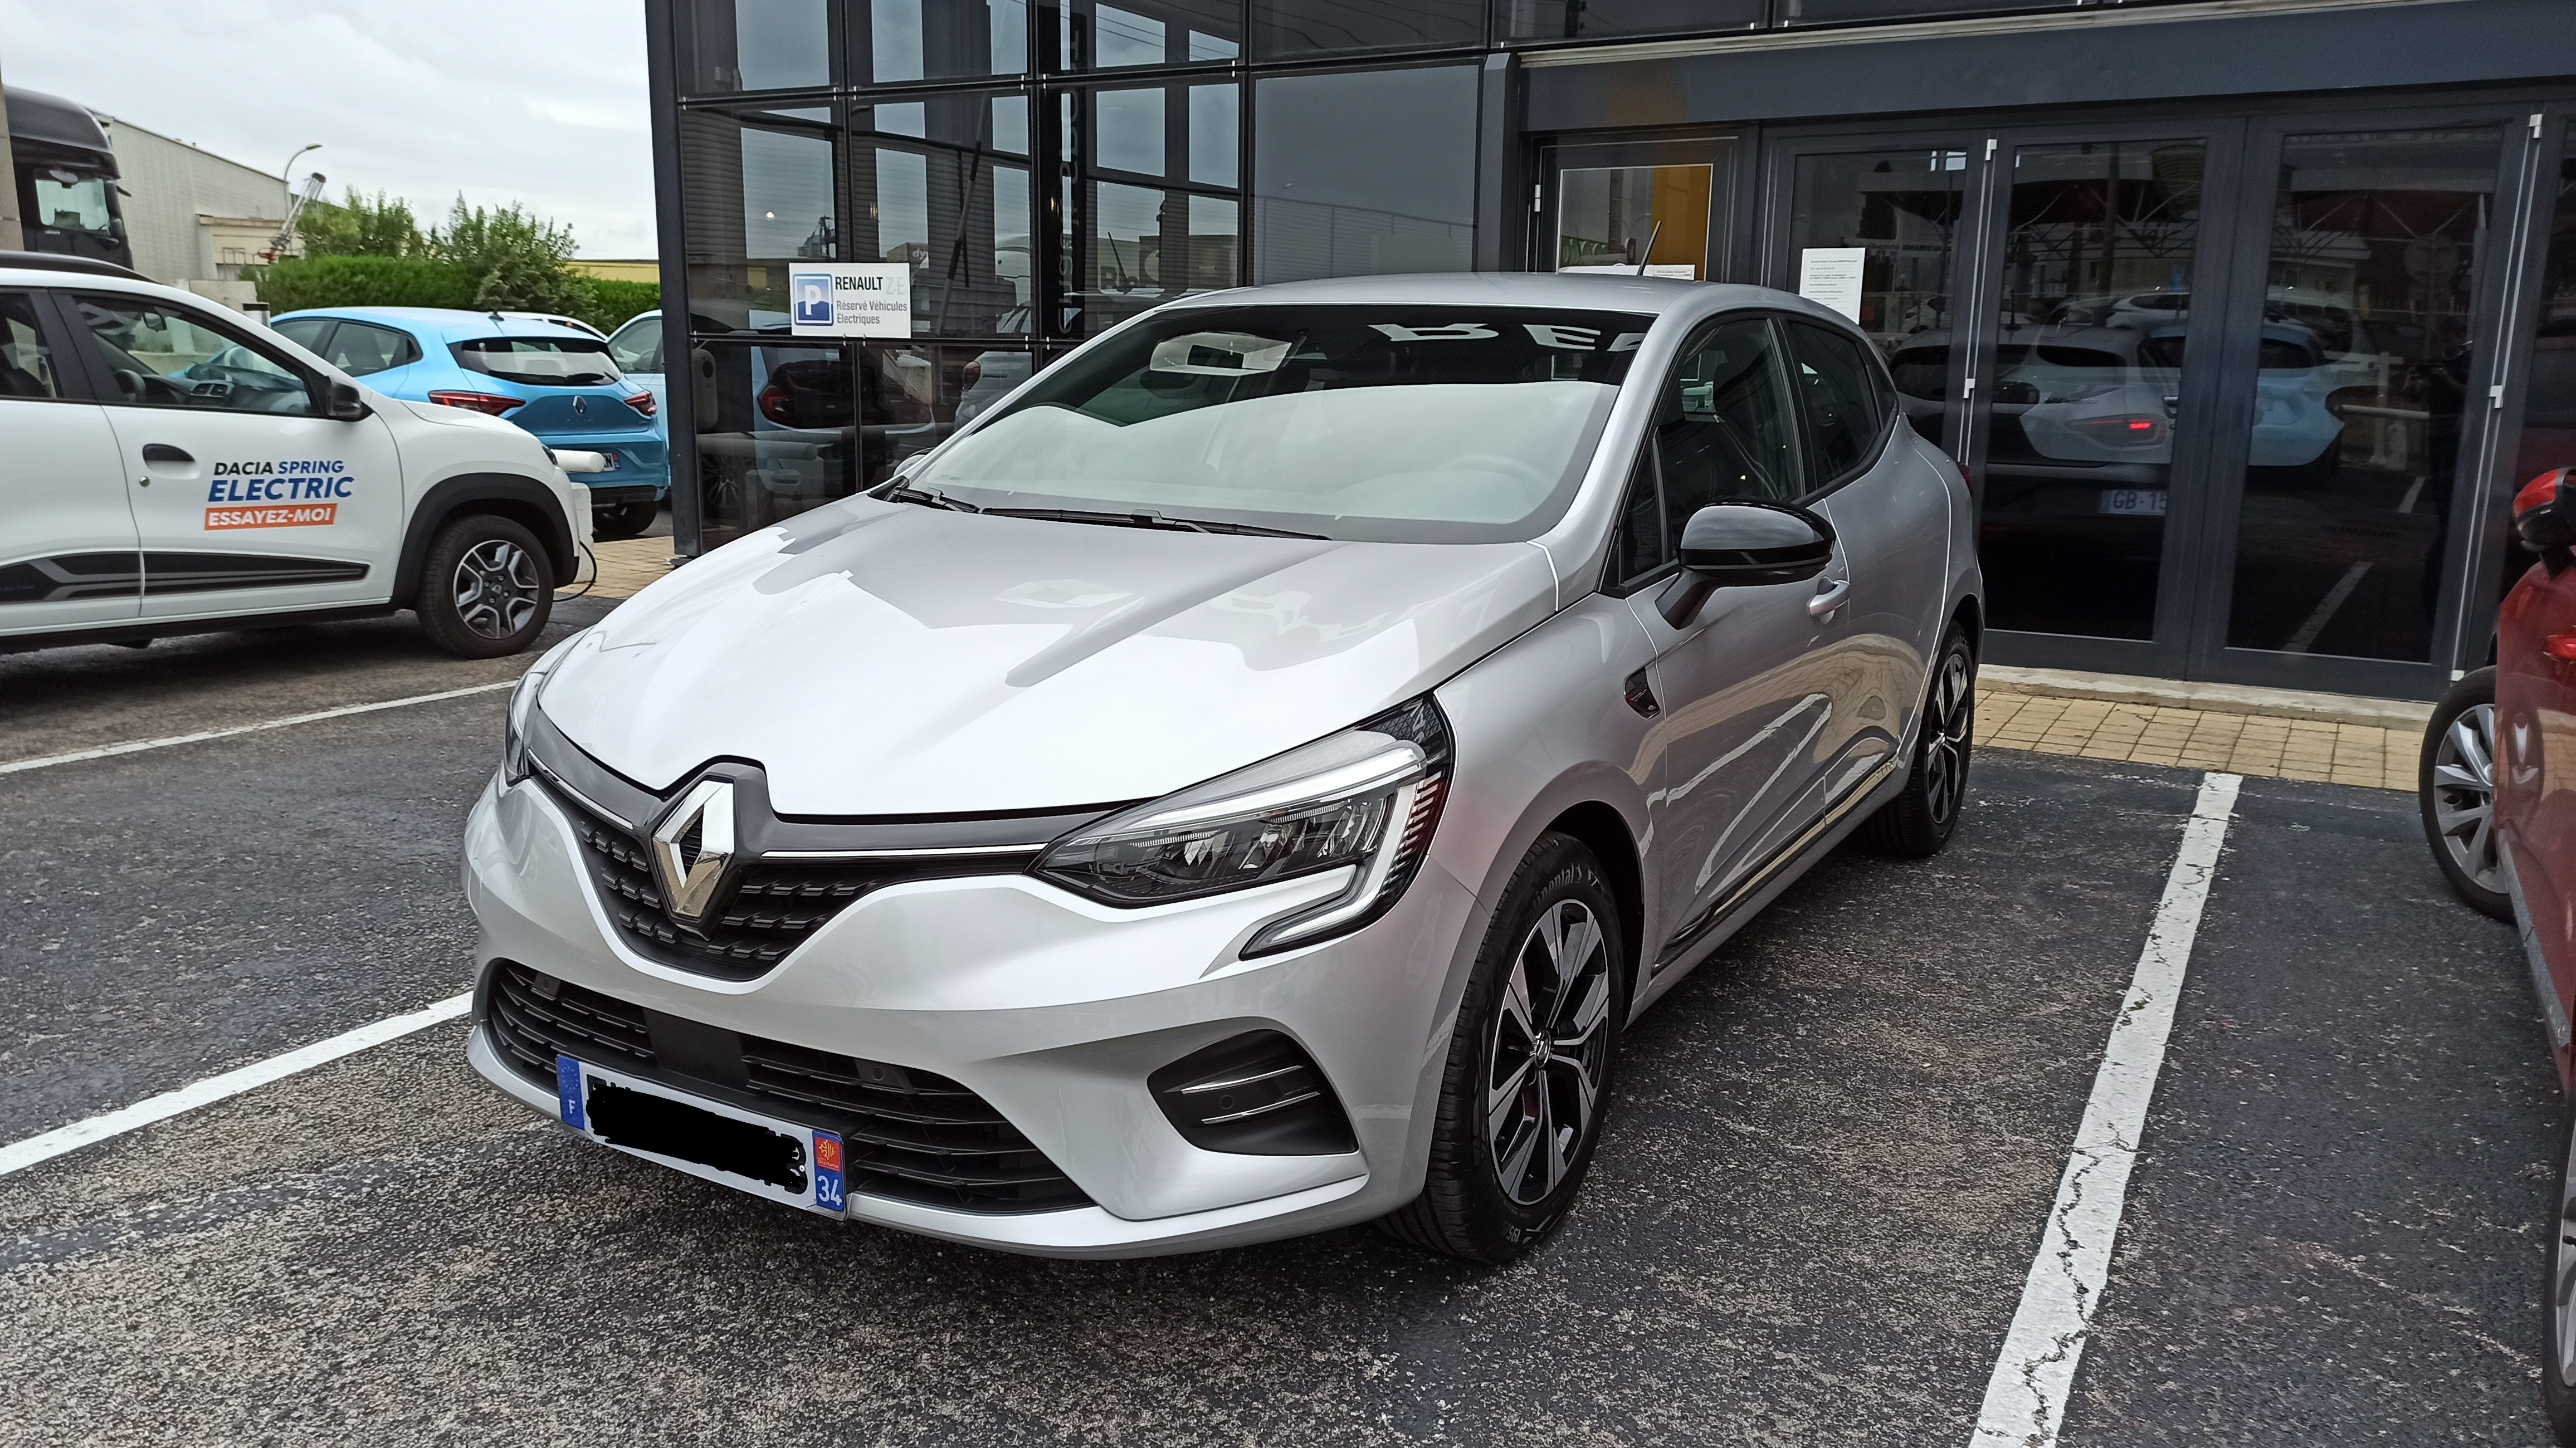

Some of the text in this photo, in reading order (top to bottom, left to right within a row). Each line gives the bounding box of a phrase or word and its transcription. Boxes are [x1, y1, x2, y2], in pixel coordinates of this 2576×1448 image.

[836, 276, 883, 291] RENAULT
[804, 284, 822, 315] P
[837, 300, 908, 312] Réservé Véhicules
[837, 311, 880, 325] Électriques
[213, 460, 345, 476] DACIA SPRING
[208, 476, 355, 502] ELECTRIC
[208, 507, 332, 526] ESSAYEZ-MOI
[568, 1099, 576, 1114] F
[817, 1175, 842, 1206] 34
